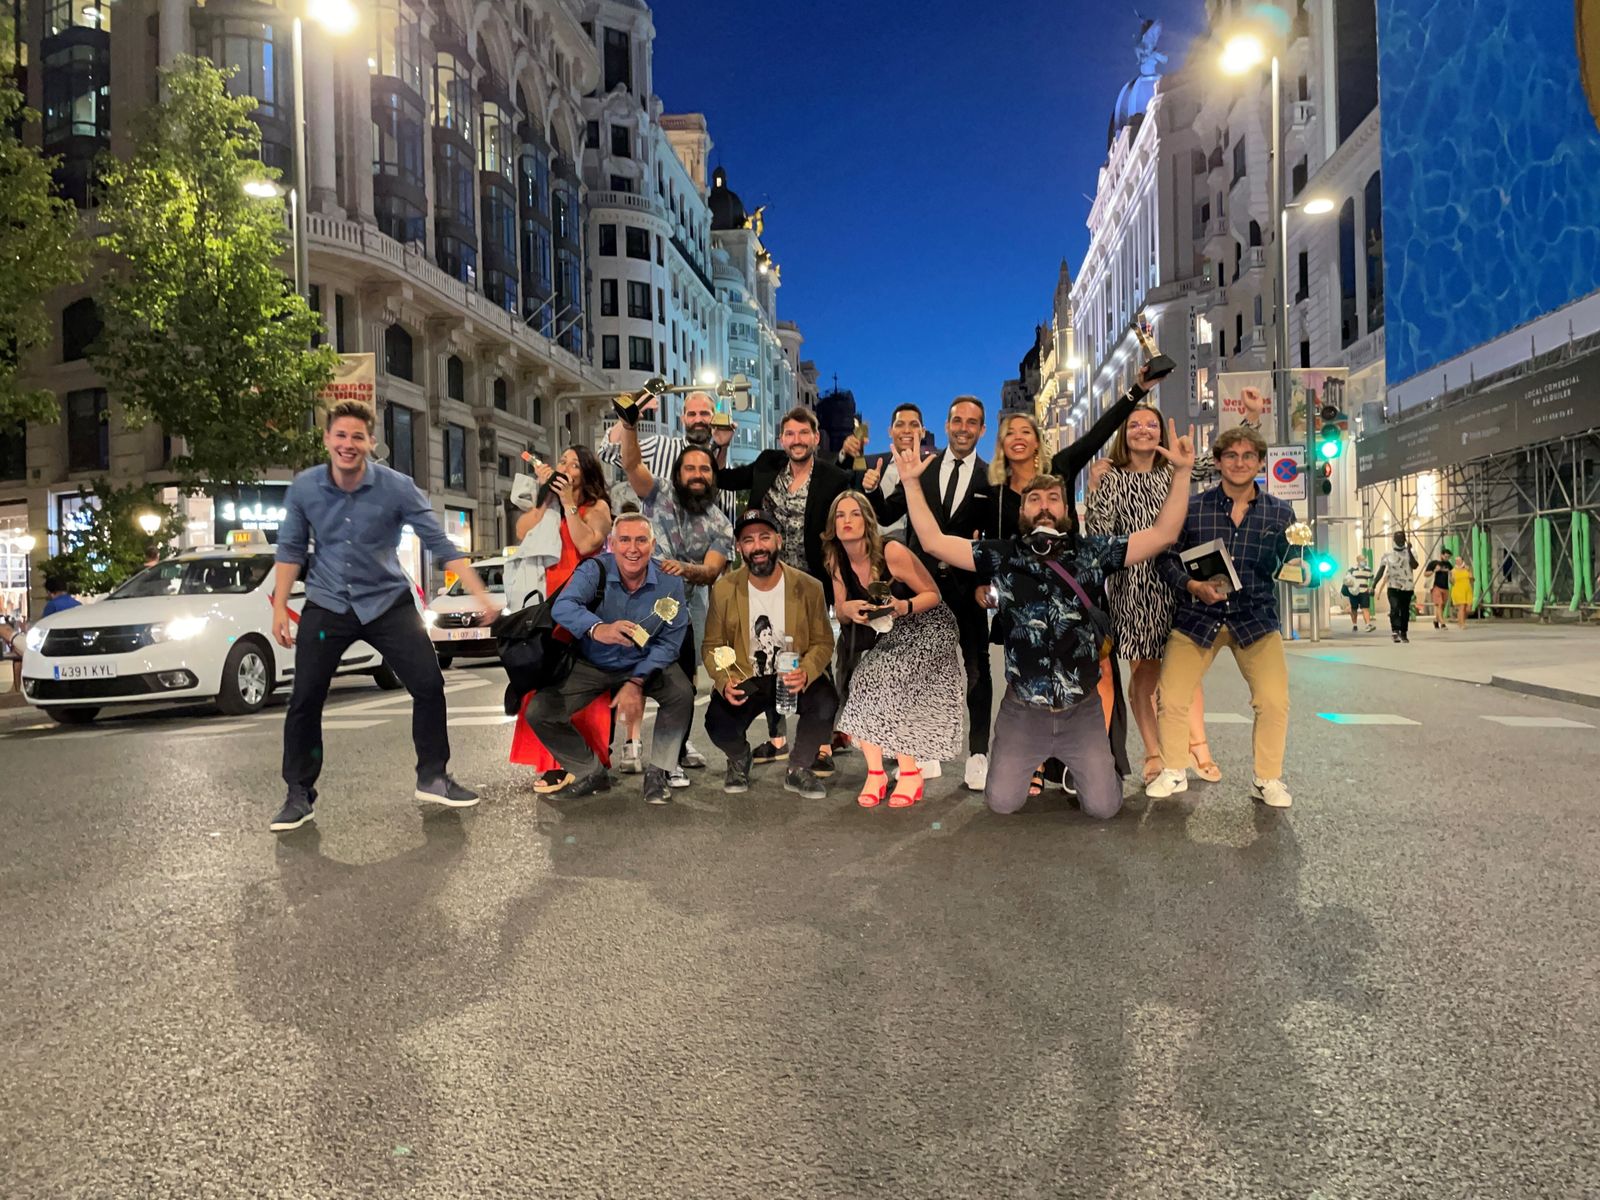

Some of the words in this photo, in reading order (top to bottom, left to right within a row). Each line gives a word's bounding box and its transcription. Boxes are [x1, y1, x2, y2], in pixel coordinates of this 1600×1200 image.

[1190, 338, 1196, 350] IS
[1524, 388, 1542, 400] LOCAL
[1544, 375, 1580, 393] COMERCIAL
[1542, 388, 1571, 404] ALQUILER
[235, 532, 250, 543] TAXI
[61, 665, 87, 677] 4391
[92, 665, 114, 676] KYL
